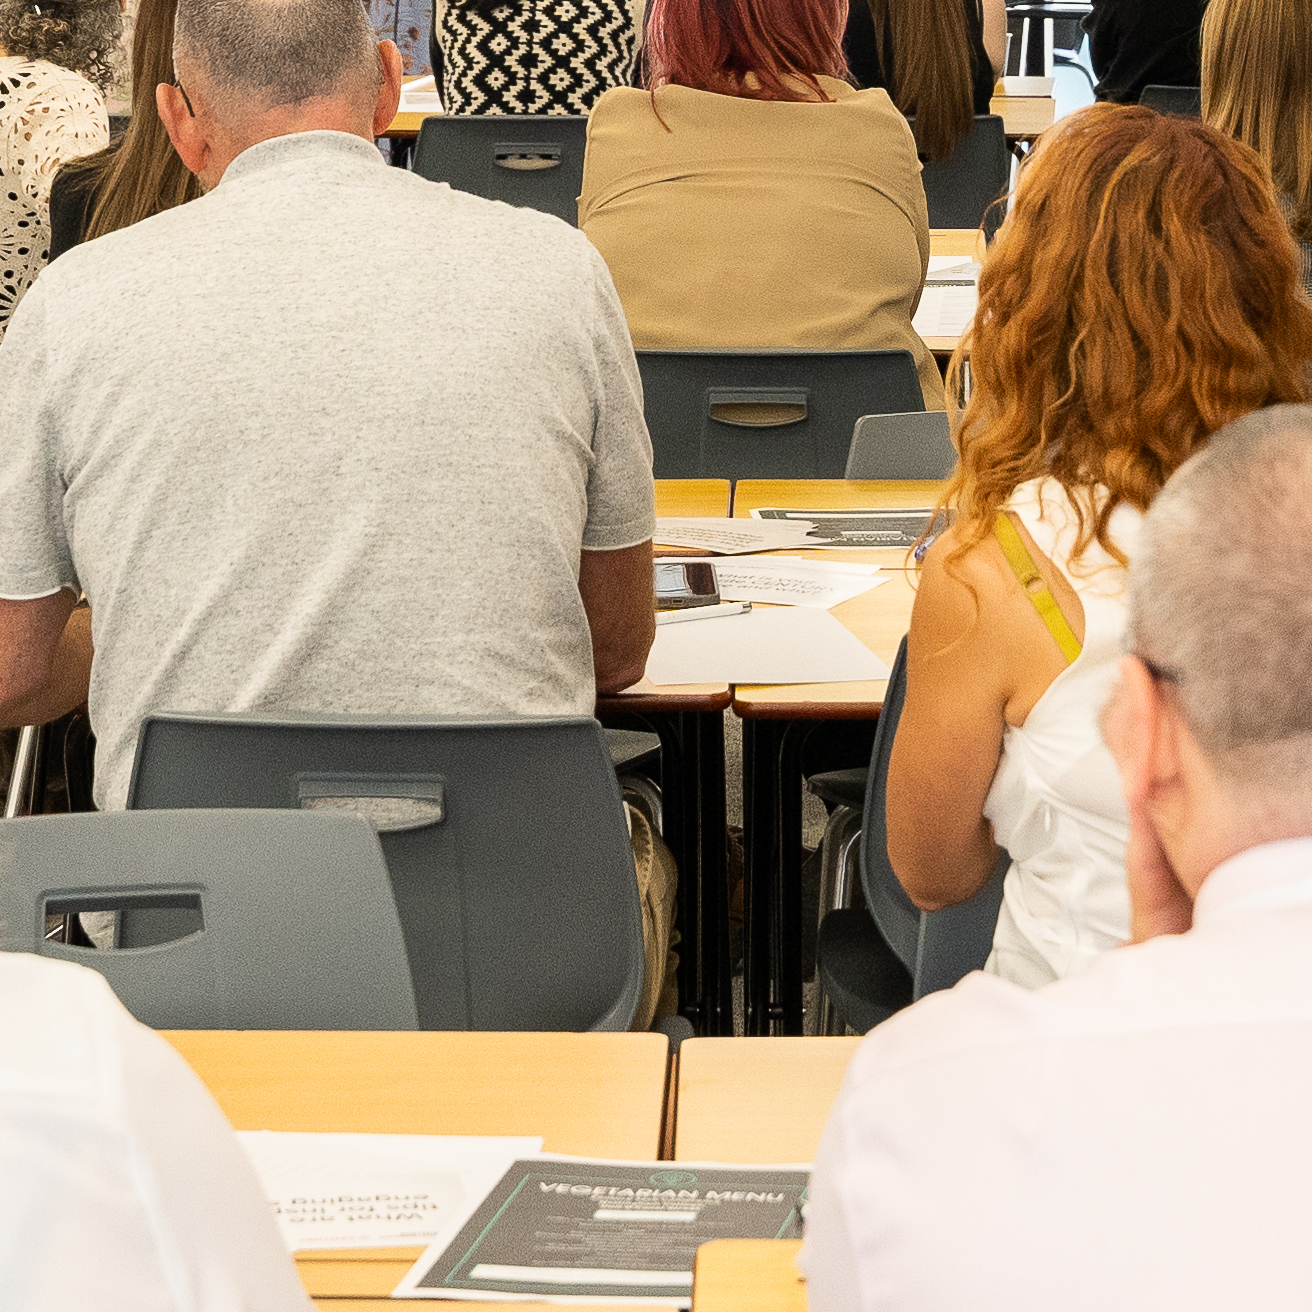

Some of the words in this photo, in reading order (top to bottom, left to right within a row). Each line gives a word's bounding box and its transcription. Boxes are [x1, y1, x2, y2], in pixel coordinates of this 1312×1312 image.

[539, 1181, 700, 1199] VEGETARIAN
[706, 1190, 785, 1204] MENU
[290, 1193, 429, 1205] engaging
[388, 1202, 438, 1212] tips
[347, 1213, 424, 1223] What
